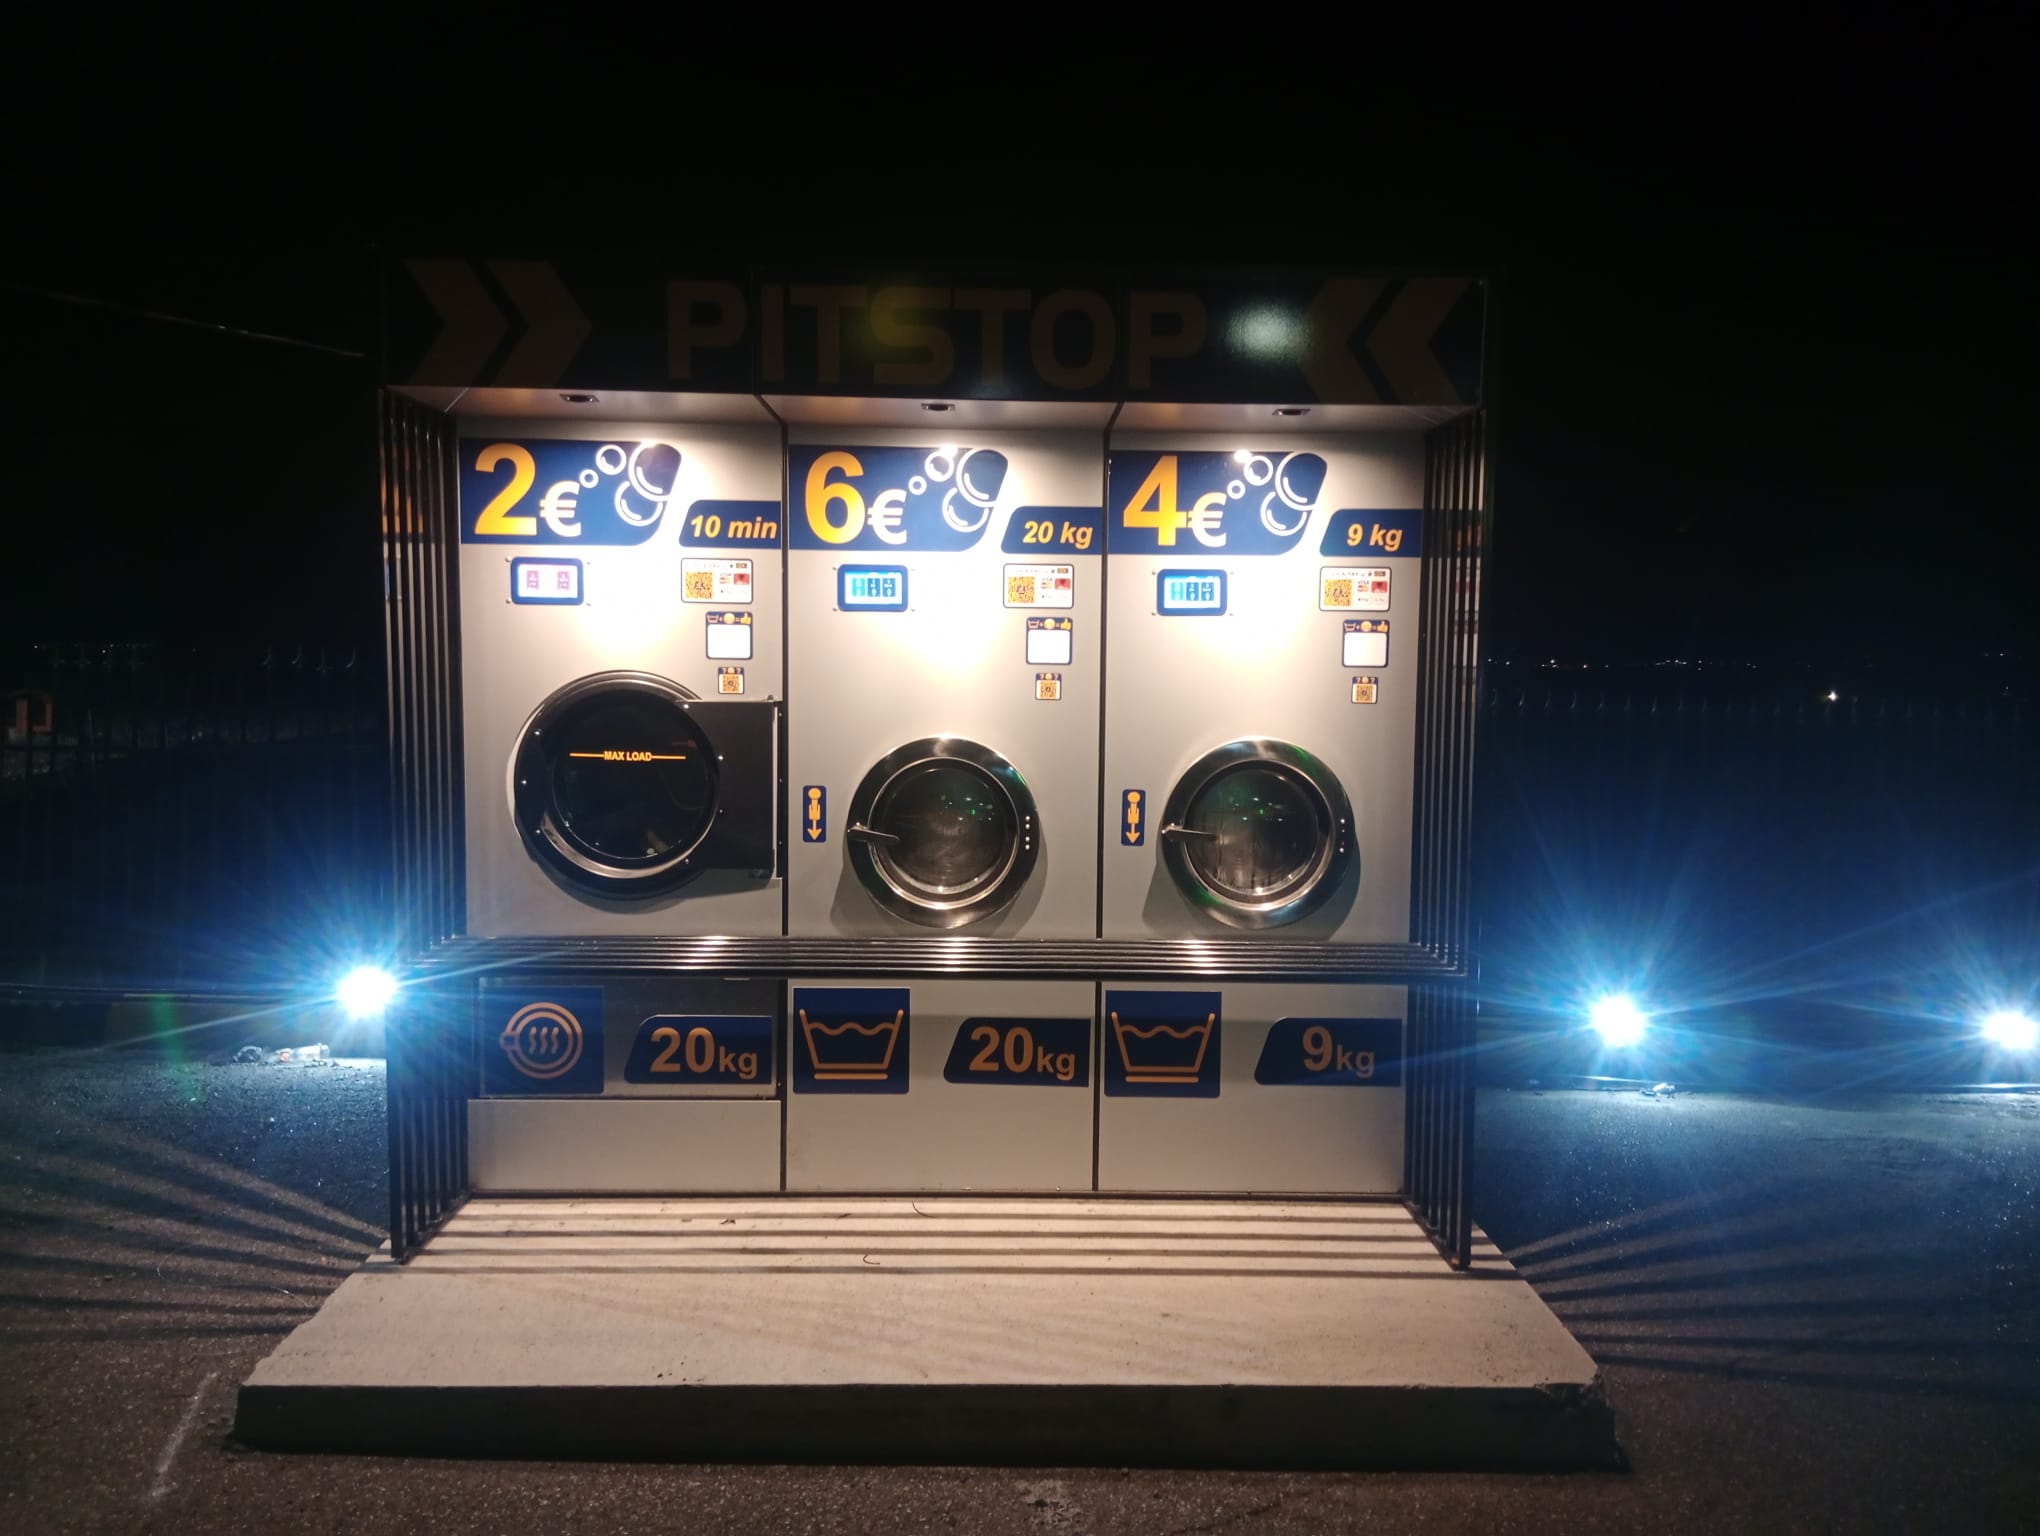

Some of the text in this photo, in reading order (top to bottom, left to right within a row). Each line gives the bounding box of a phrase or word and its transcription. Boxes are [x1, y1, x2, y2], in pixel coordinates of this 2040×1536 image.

[666, 280, 1208, 390] PITSTOP
[474, 442, 582, 538] 2€
[805, 451, 908, 545] 6€
[1123, 455, 1227, 548] 4€
[690, 515, 778, 539] 10 min
[1022, 521, 1093, 549] 20 kg
[1347, 524, 1402, 551] 9 kg
[604, 751, 652, 761] MAX LOAD
[650, 1026, 758, 1080] 20kg
[969, 1025, 1075, 1081] 20kg
[1302, 1025, 1375, 1078] 9kg
